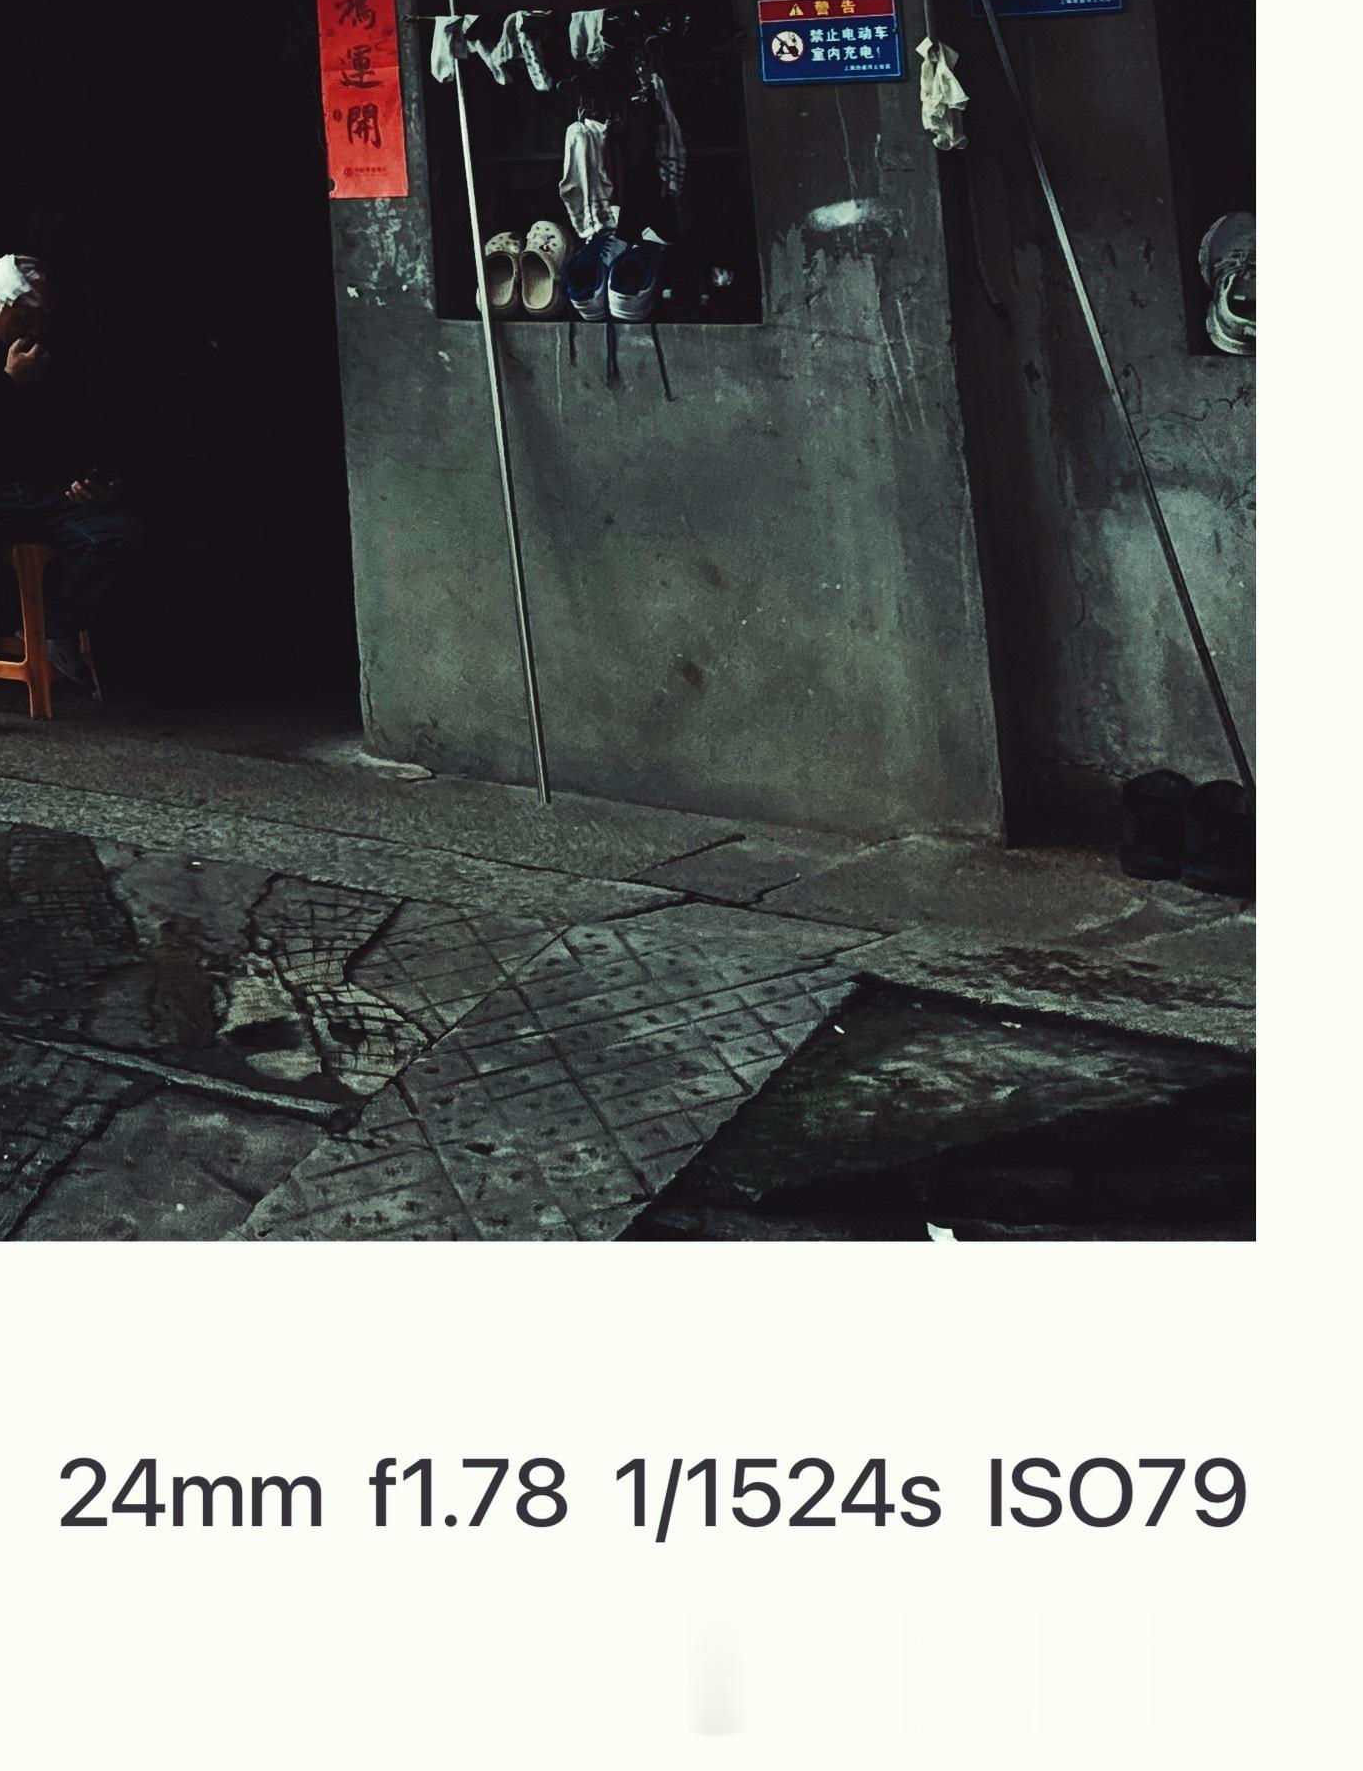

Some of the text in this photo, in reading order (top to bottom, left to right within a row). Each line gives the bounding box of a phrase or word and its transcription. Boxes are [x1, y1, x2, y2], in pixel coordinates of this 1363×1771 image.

[813, 0, 856, 16] 警告
[809, 26, 888, 43] 禁止电动车
[810, 44, 881, 62] 室内充电！
